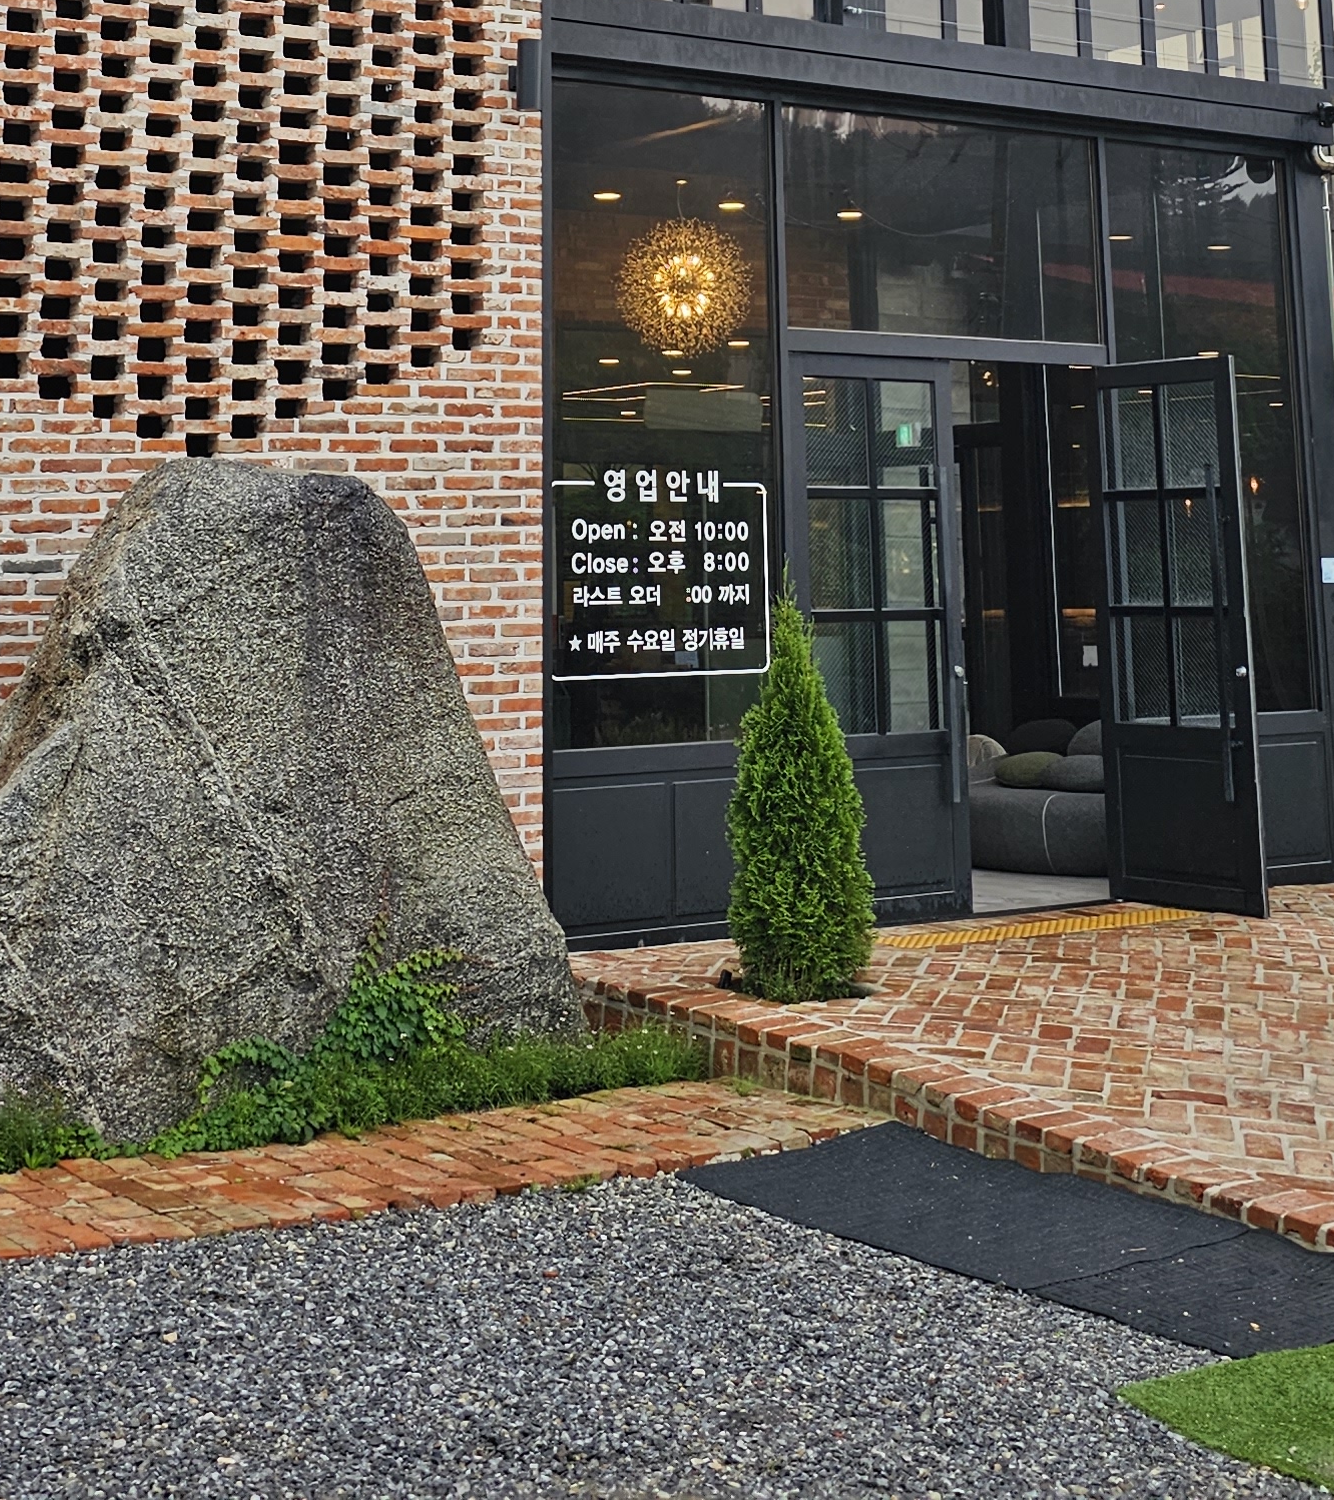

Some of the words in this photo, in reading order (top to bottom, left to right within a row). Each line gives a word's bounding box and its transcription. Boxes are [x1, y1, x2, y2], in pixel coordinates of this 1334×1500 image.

[603, 469, 720, 504] 영업안내
[648, 519, 687, 543] 오전
[694, 520, 749, 542] 10:00
[647, 550, 686, 575] 오후
[703, 552, 750, 573] 8:00
[572, 585, 624, 607] 라스트
[628, 584, 661, 606] 오더
[717, 583, 750, 606] 까지
[587, 630, 621, 654] 매주
[626, 628, 676, 654] 수요일
[681, 626, 745, 652] 정기휴일
